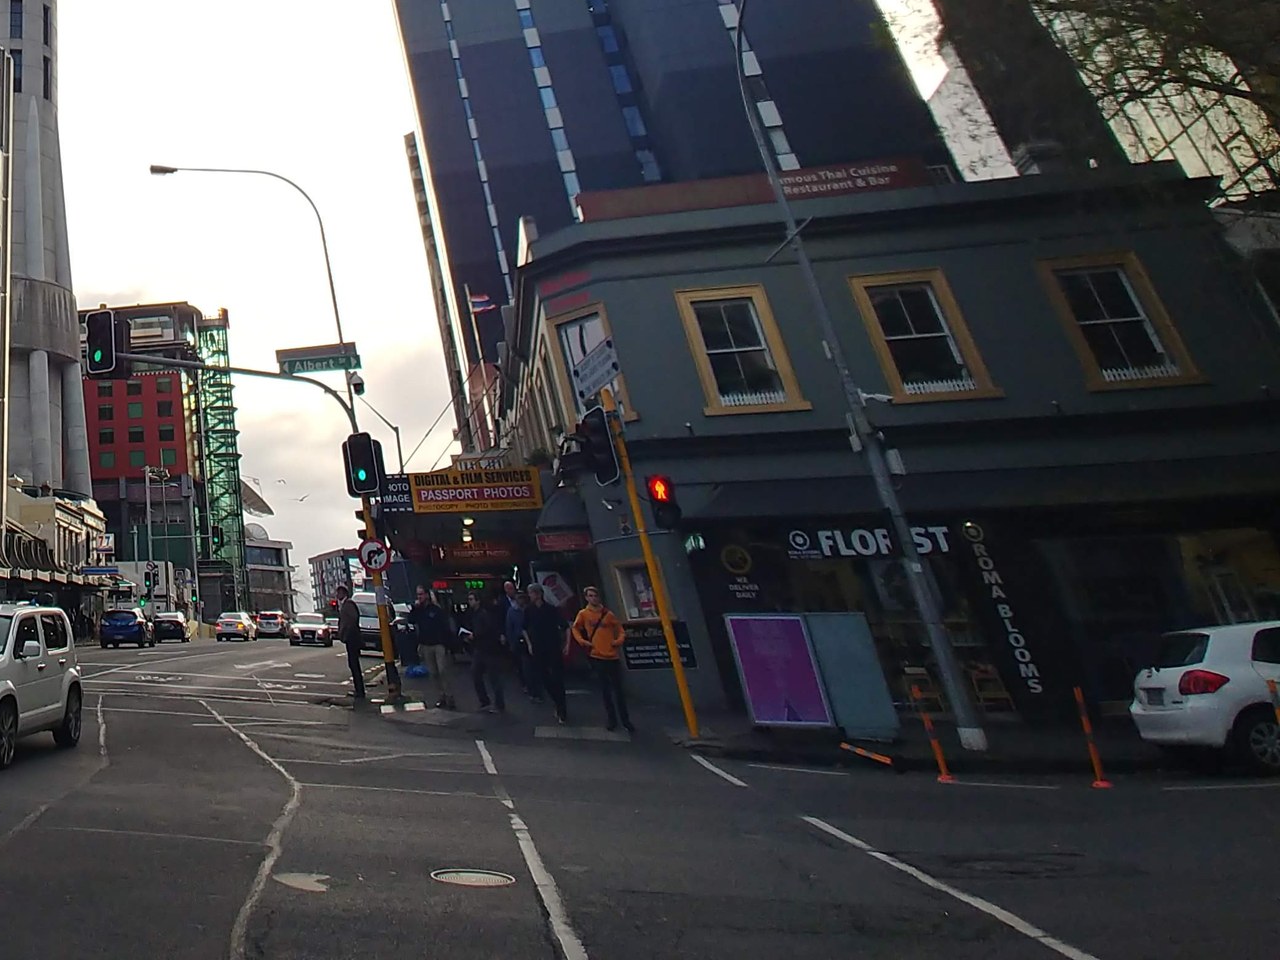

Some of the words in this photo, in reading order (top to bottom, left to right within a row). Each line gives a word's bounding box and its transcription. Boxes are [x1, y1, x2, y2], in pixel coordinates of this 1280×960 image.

[779, 174, 817, 185] mous
[818, 169, 847, 181] Thai
[849, 164, 898, 178] Cuisine
[782, 180, 854, 195] Restaurant
[856, 177, 867, 188] &
[868, 176, 891, 186] Bar
[294, 359, 335, 372] Albert
[414, 474, 451, 487] DIGITAL
[452, 475, 460, 486] &
[461, 472, 483, 485] FILM
[485, 470, 532, 483] SERVICES
[421, 488, 478, 501] PASSPORT
[484, 486, 530, 499] PHOTOS
[817, 526, 949, 556] FLORST
[973, 543, 1004, 599] ROMA
[997, 603, 1043, 694] BLOOMS
